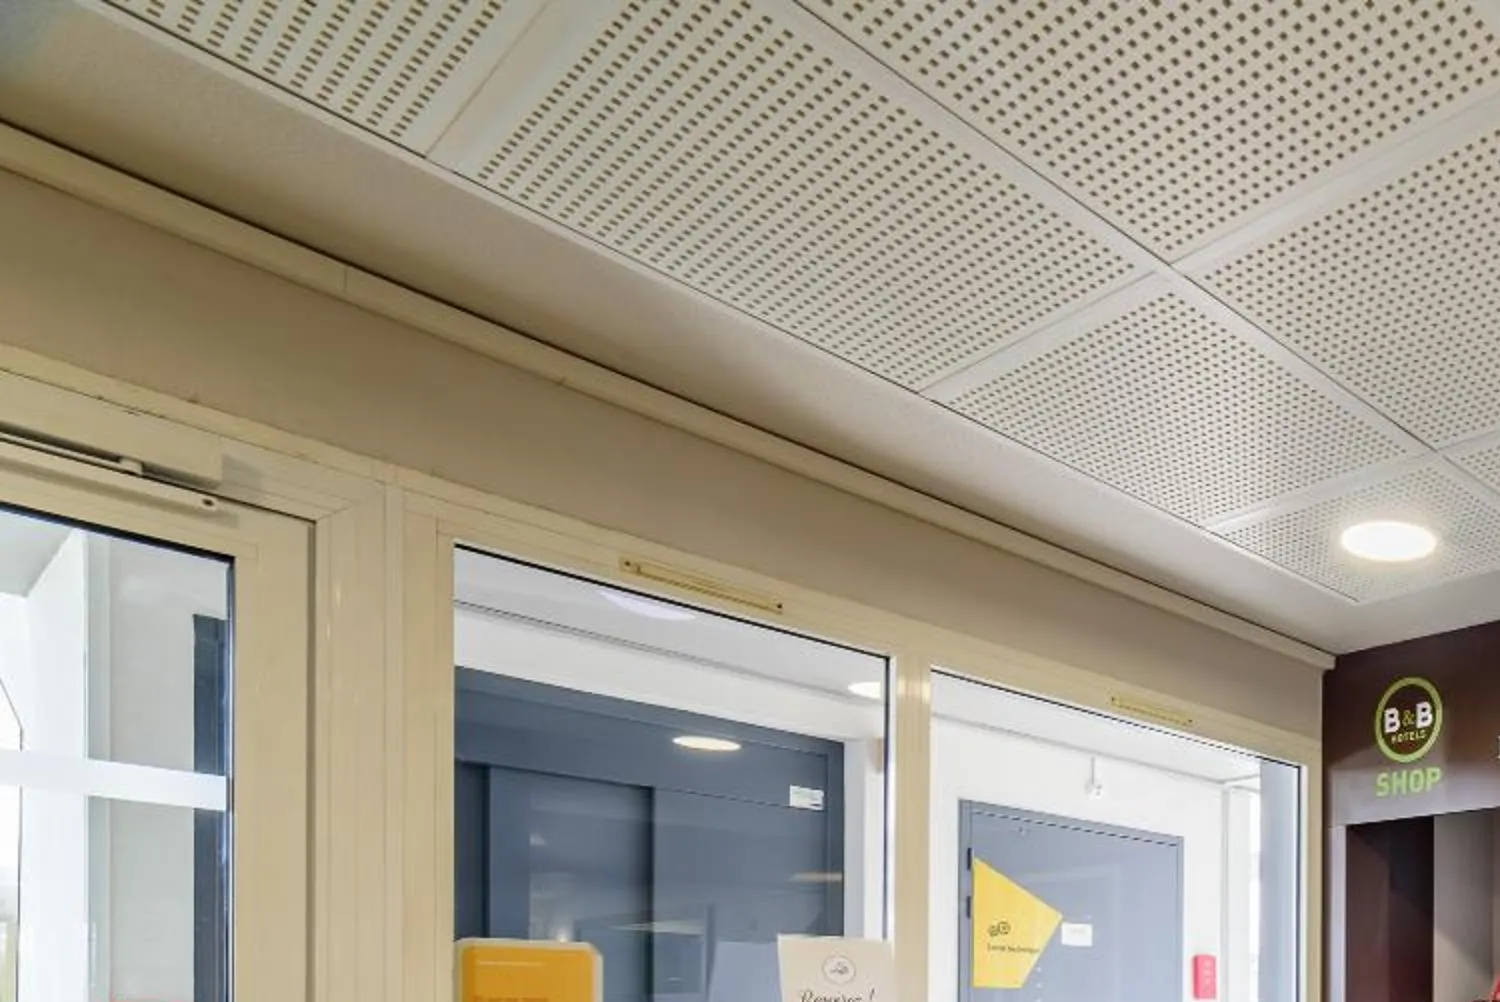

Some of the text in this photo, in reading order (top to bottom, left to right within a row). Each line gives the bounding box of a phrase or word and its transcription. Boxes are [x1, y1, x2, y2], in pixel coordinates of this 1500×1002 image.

[1384, 701, 1433, 734] B&B
[1391, 729, 1427, 744] HOTELS
[1376, 766, 1442, 797] SHOP
